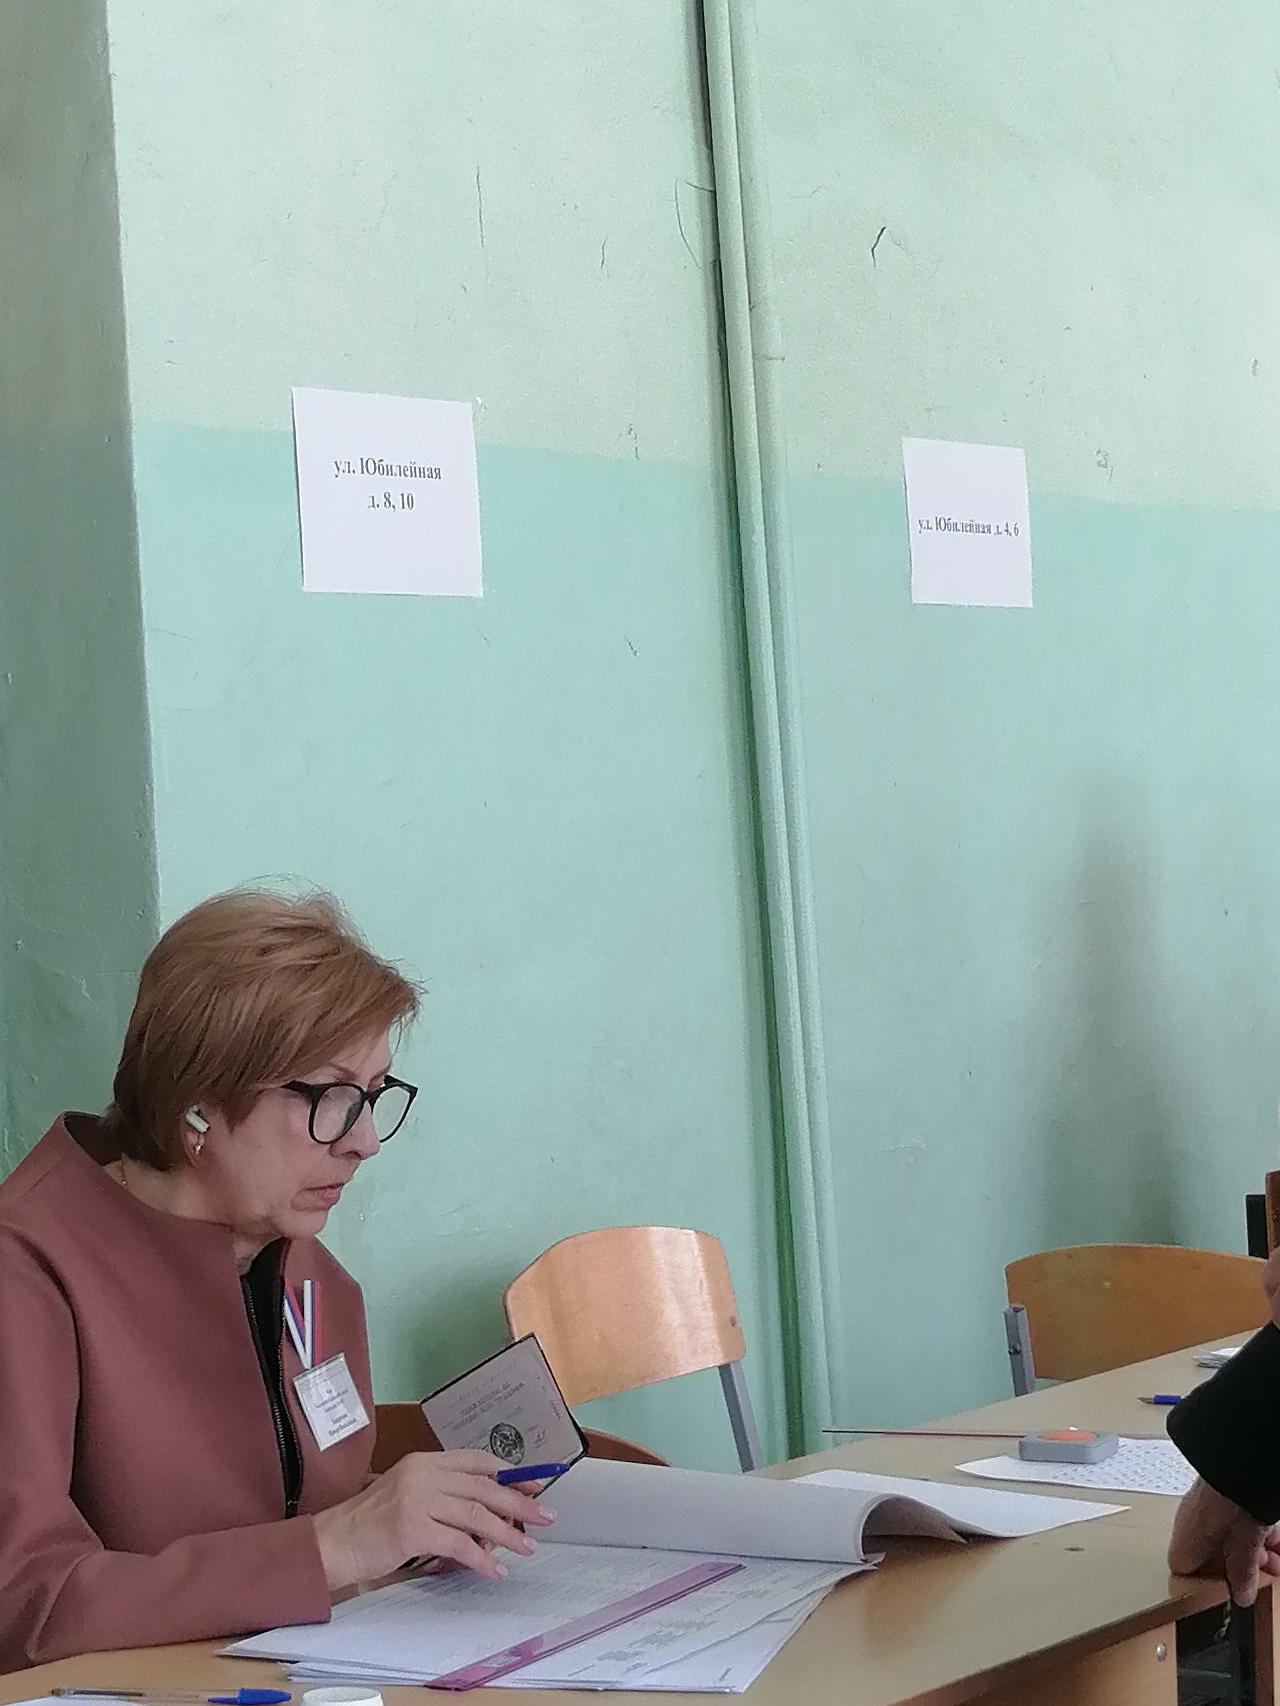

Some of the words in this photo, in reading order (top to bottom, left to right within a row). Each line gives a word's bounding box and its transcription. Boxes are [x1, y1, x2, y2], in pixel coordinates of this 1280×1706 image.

[334, 459, 356, 478] ул.
[360, 457, 442, 480] Юбилейная
[367, 494, 380, 509] д.
[383, 491, 396, 512] 8,
[400, 492, 414, 510] 10
[918, 519, 933, 534] ул.
[934, 516, 992, 535] Юбилейная
[1013, 522, 1020, 537] 6
